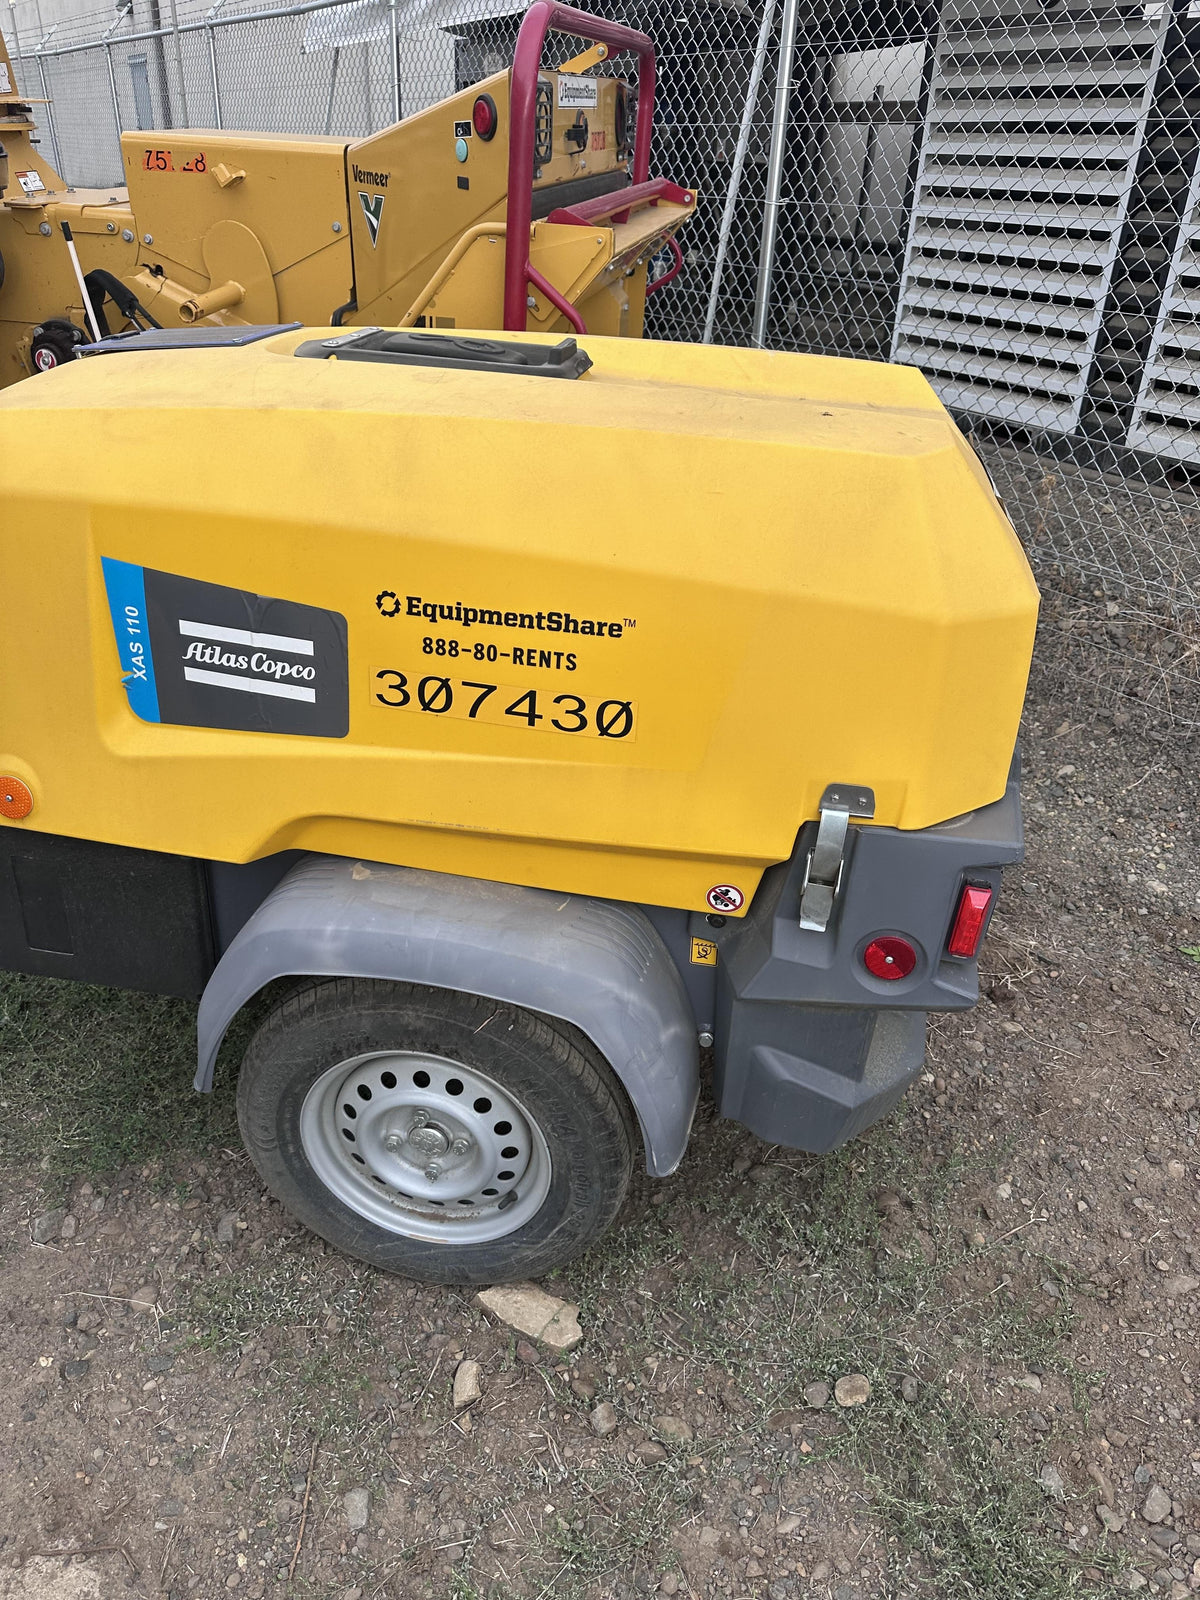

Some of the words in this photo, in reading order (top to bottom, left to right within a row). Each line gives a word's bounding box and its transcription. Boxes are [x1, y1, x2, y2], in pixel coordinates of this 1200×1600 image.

[124, 605, 141, 636] 110
[129, 641, 148, 682] XAS
[182, 641, 249, 670] Atlas
[249, 652, 317, 681] Copco
[422, 636, 578, 671] 888-80-RENTS
[375, 669, 634, 739] 307430
